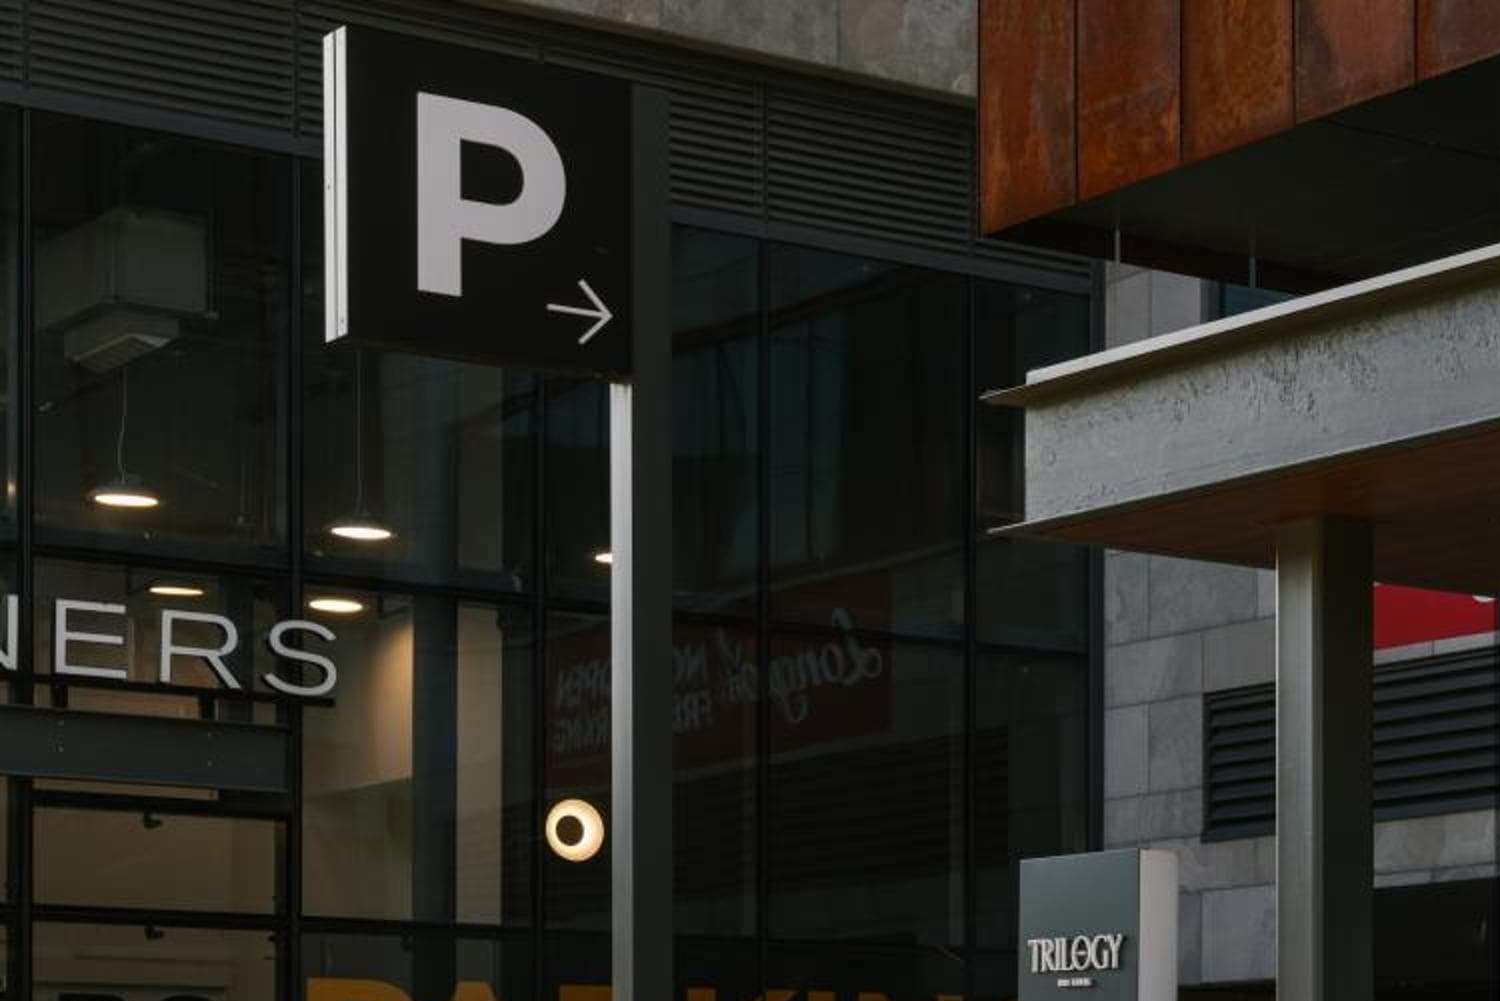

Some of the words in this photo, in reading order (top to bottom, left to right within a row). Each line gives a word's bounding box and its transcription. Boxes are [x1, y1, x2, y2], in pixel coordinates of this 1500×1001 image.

[418, 92, 566, 297] P
[0, 594, 338, 697] ERS
[1027, 933, 1124, 974] TRILOGY
